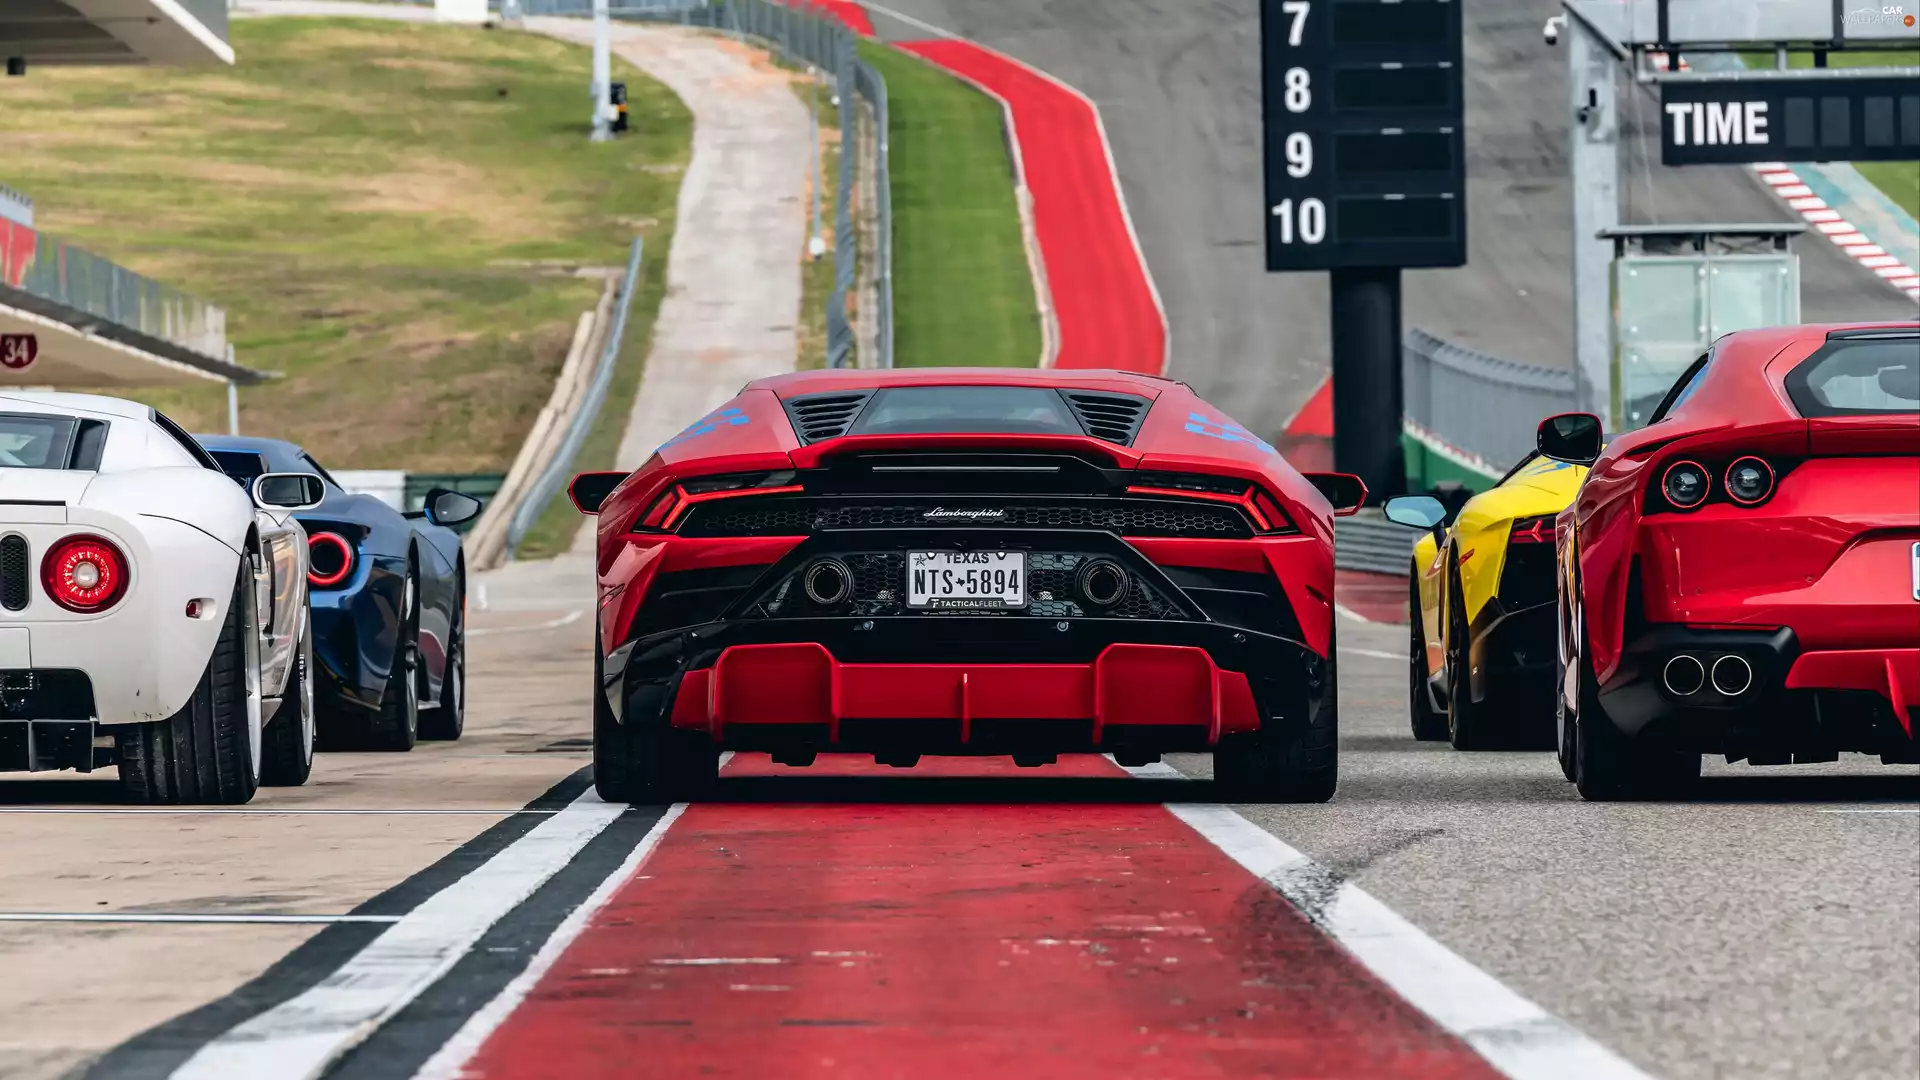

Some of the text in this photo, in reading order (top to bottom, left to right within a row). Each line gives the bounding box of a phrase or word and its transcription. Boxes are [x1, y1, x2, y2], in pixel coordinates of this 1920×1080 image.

[1282, 1, 1311, 46] 7
[1284, 66, 1312, 113] 8
[1665, 101, 1769, 146] TIME
[1285, 131, 1313, 178] 9
[1272, 197, 1326, 244] 10
[4, 338, 29, 363] 34
[923, 506, 1004, 519] Lamborghini
[945, 552, 990, 564] TEXAS
